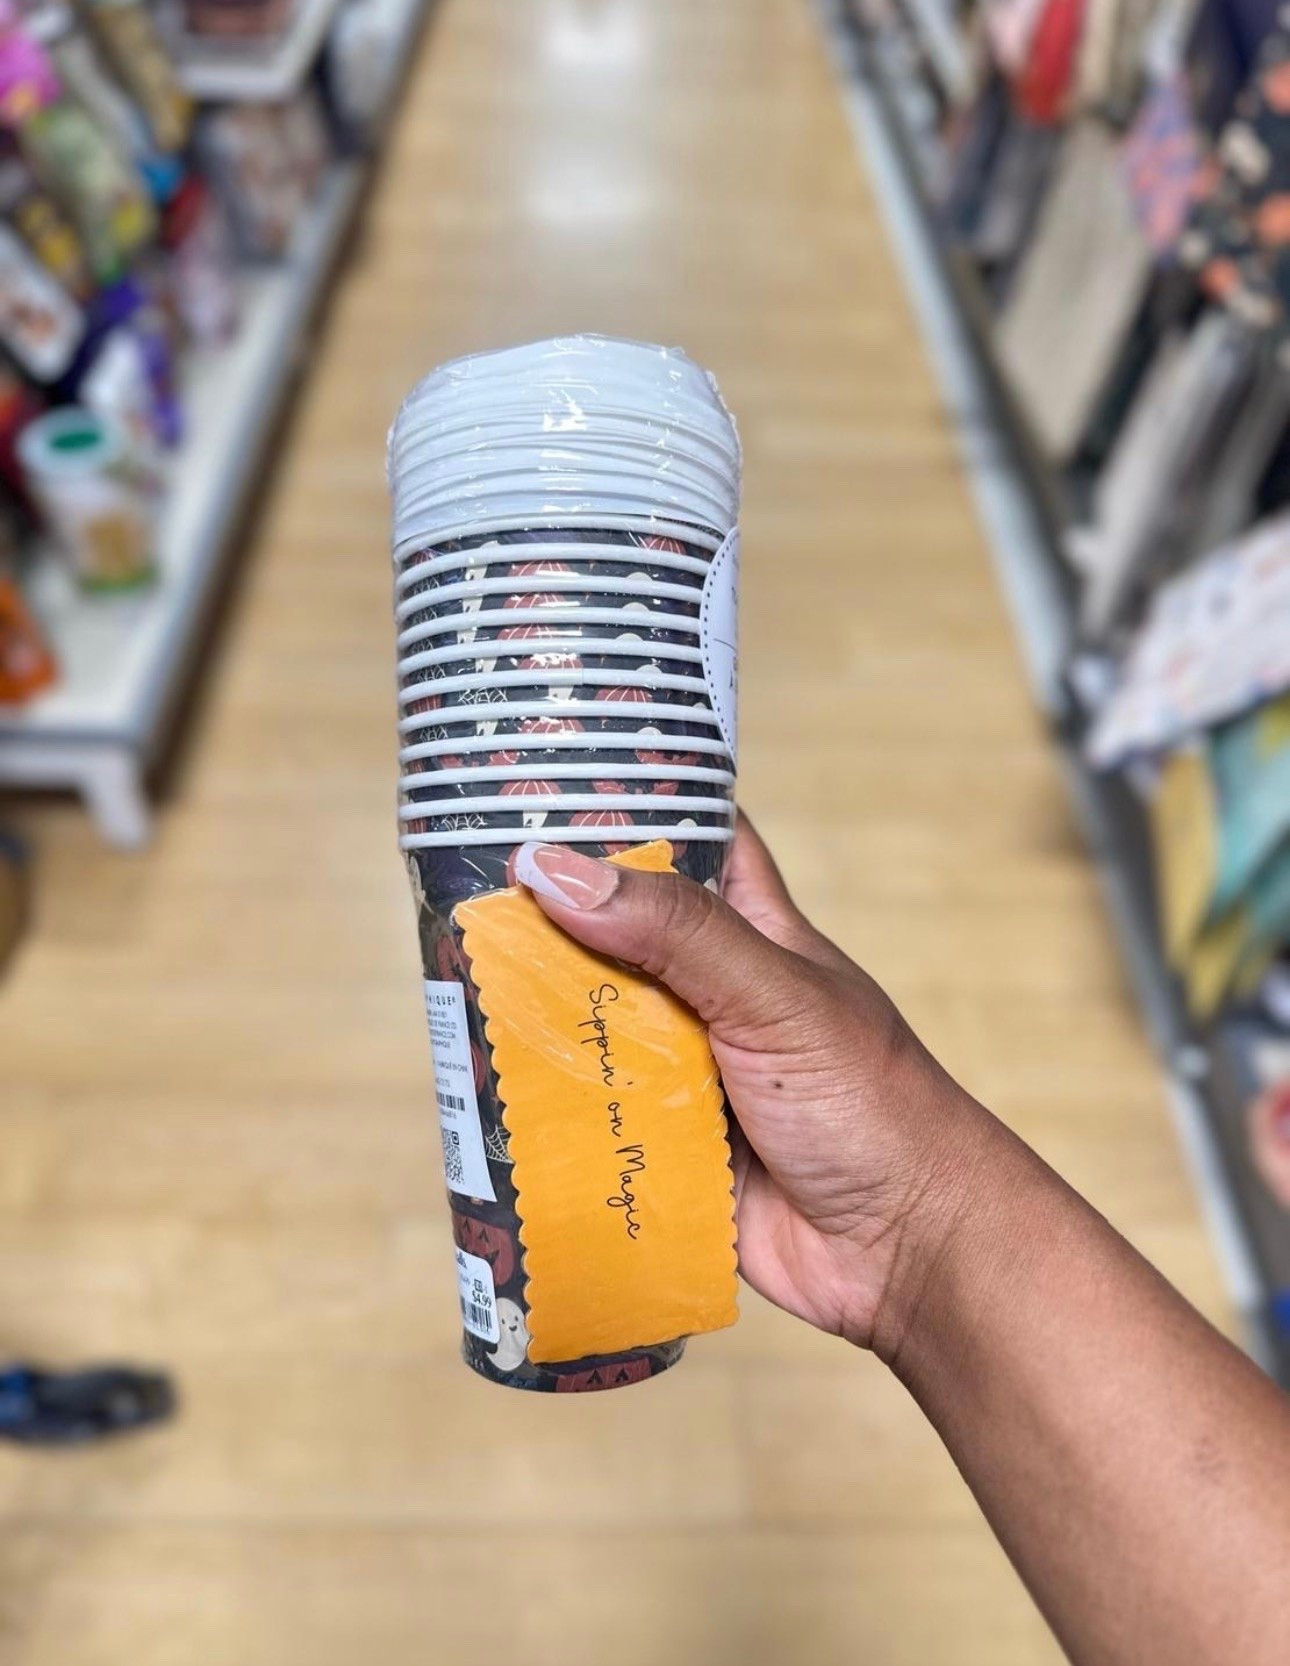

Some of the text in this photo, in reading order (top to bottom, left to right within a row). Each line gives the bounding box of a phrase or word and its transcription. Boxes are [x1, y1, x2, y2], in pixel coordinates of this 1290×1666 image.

[577, 983, 646, 1240] Sippin' on Magic
